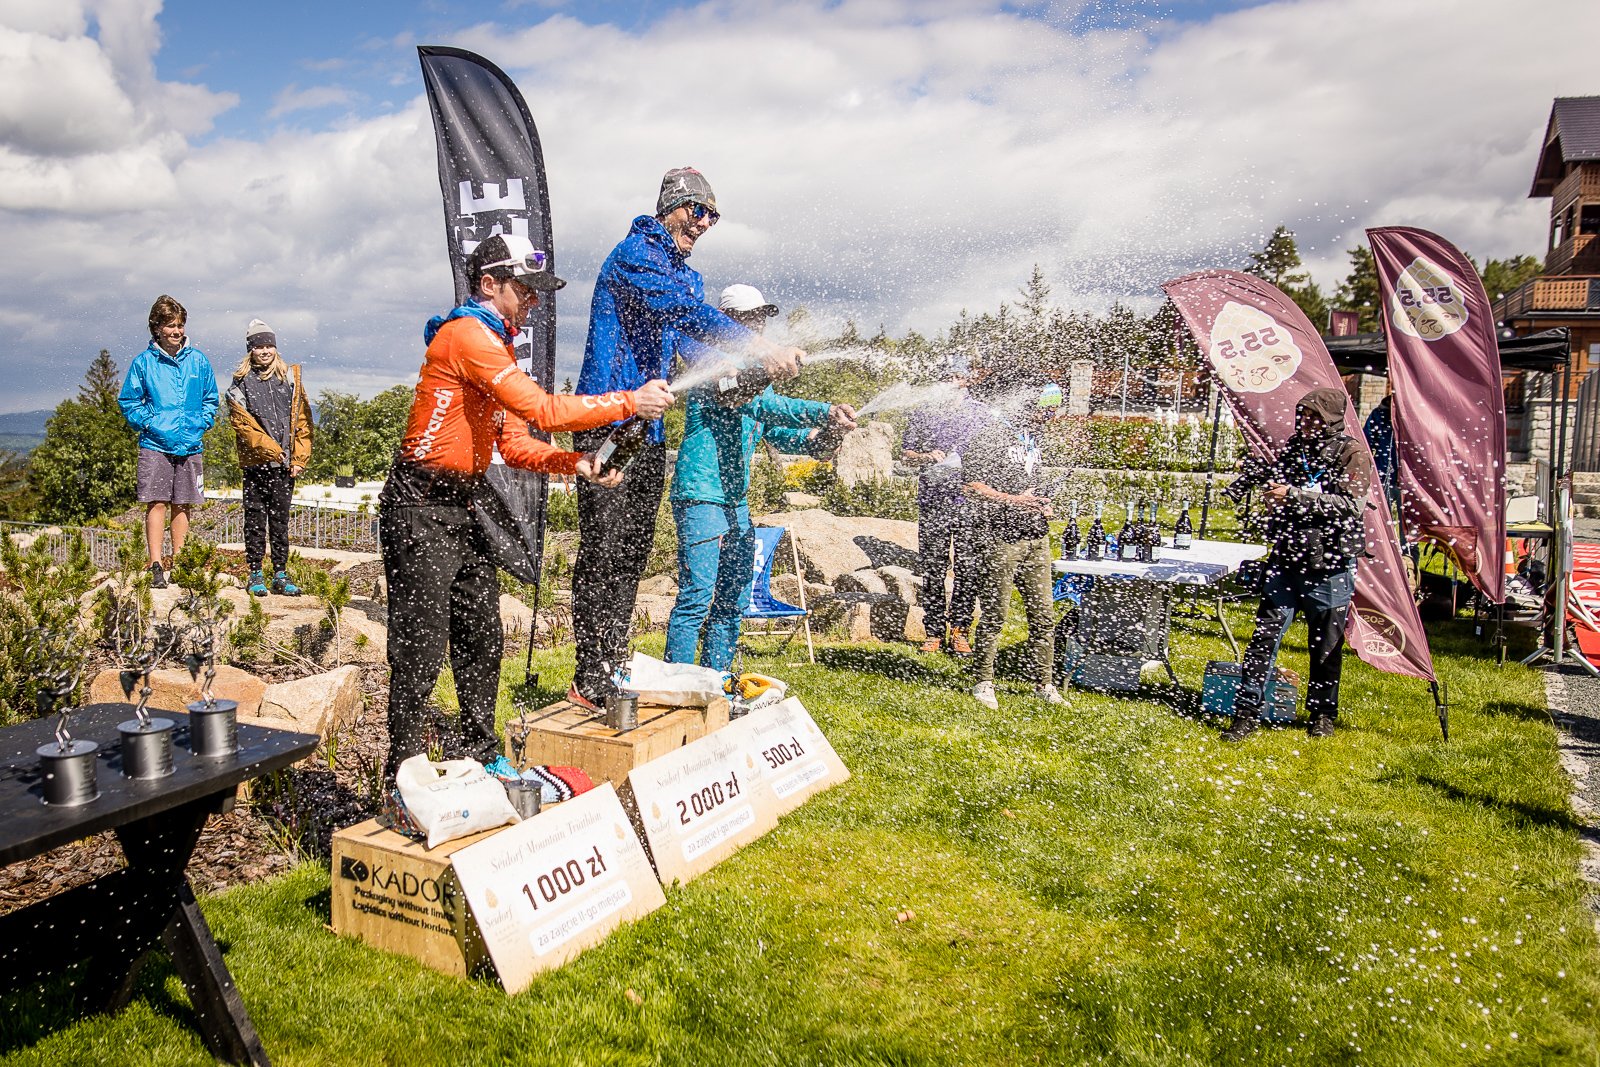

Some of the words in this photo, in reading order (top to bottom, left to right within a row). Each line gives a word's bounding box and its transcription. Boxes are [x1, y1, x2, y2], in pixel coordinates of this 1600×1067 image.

[413, 388, 454, 459] sprandi
[762, 743, 793, 769] 500
[790, 736, 805, 757] zł
[726, 771, 740, 799] zł
[526, 831, 566, 855] Mountain
[585, 845, 607, 878] zł
[354, 885, 397, 908] Packaging
[397, 898, 429, 915] without
[371, 864, 457, 910] KADOR
[352, 899, 387, 917] Logistics
[388, 911, 420, 927] without
[538, 933, 549, 947] za
[598, 888, 626, 911] miejsca
